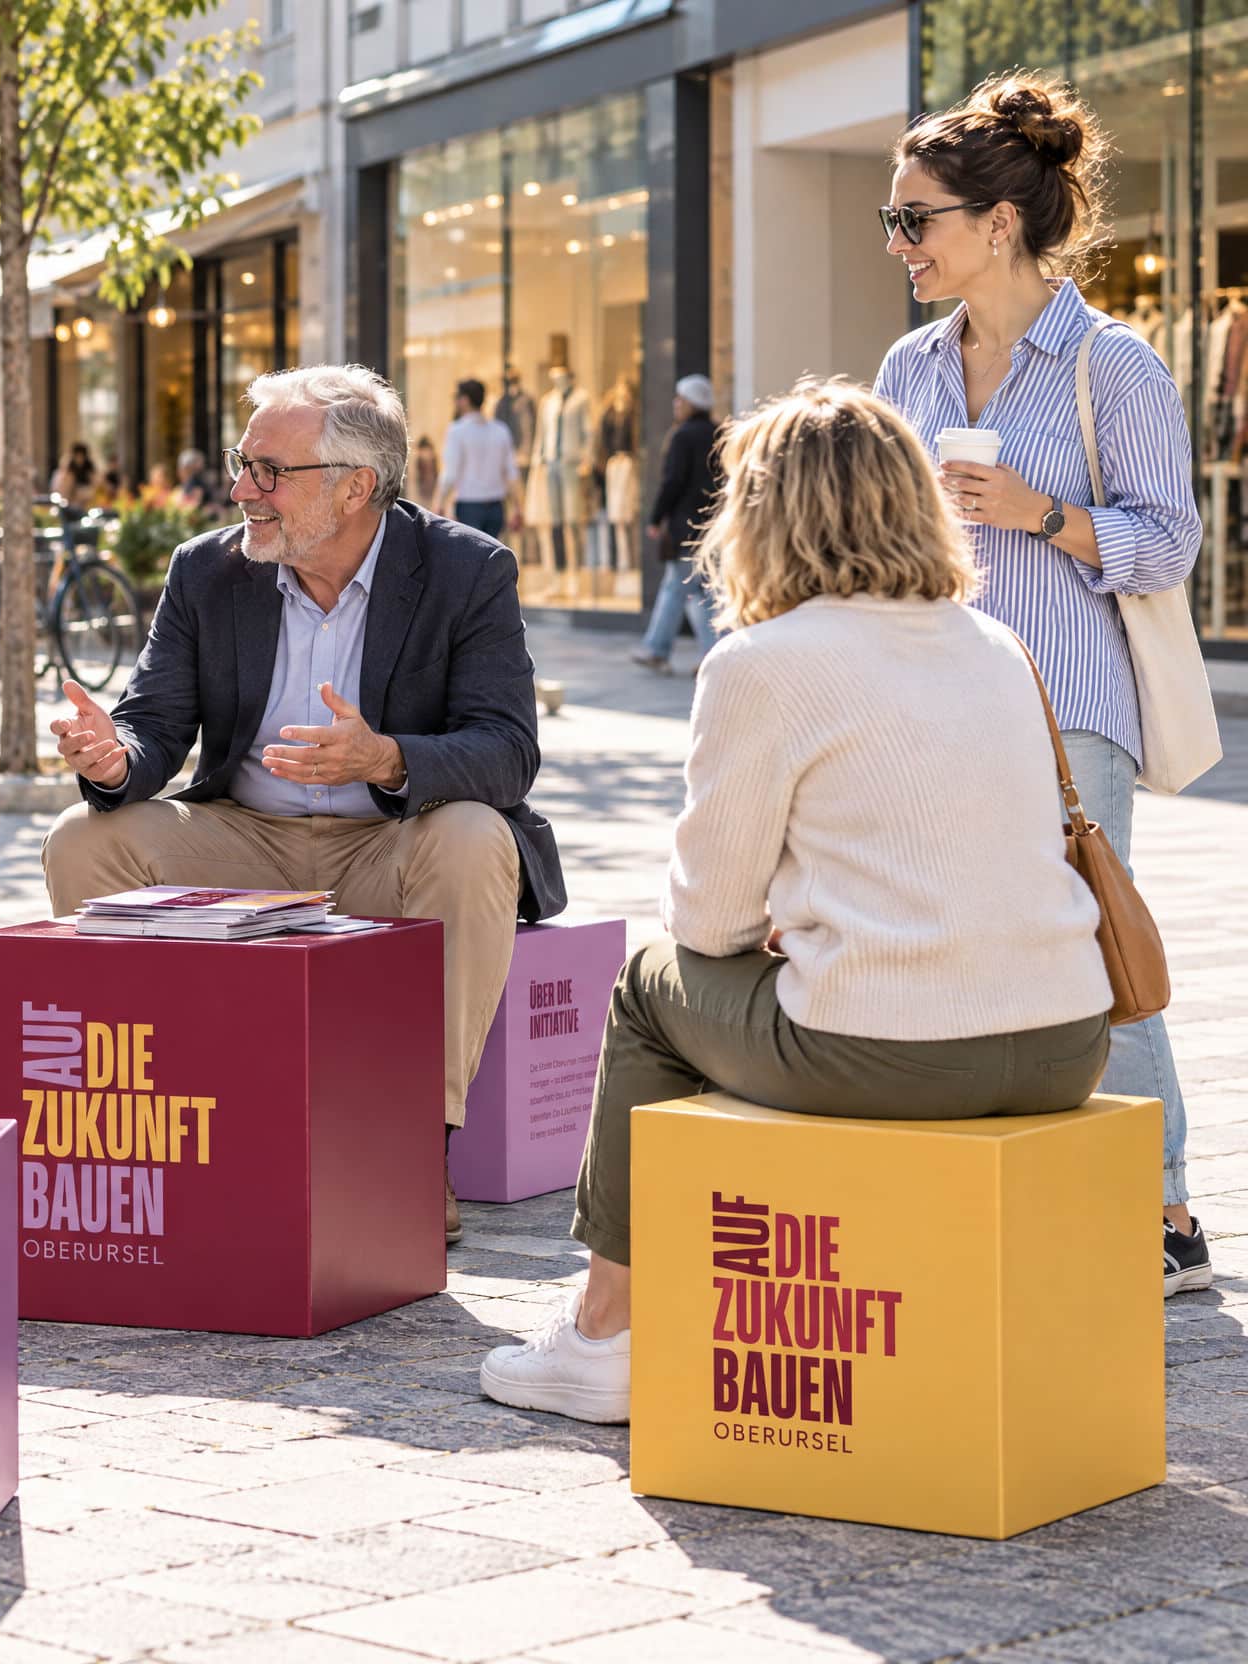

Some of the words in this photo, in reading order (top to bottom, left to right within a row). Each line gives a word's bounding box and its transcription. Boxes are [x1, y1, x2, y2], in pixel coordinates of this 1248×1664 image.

[529, 979, 554, 1010] ÜBER
[557, 979, 572, 1006] DIE
[529, 1008, 579, 1040] INITIATIVE
[22, 1001, 83, 1088] AUF
[86, 1022, 154, 1091] DIE
[22, 1089, 217, 1164] ZUKUNFT
[22, 1161, 164, 1236] BAUEN
[712, 1191, 770, 1278] AUF
[23, 1239, 164, 1265] OBERURSEL
[775, 1213, 840, 1282] DIE
[713, 1277, 902, 1357] ZUKUNFT
[713, 1347, 853, 1426] BAUEN
[714, 1422, 853, 1454] OBERURSEL
